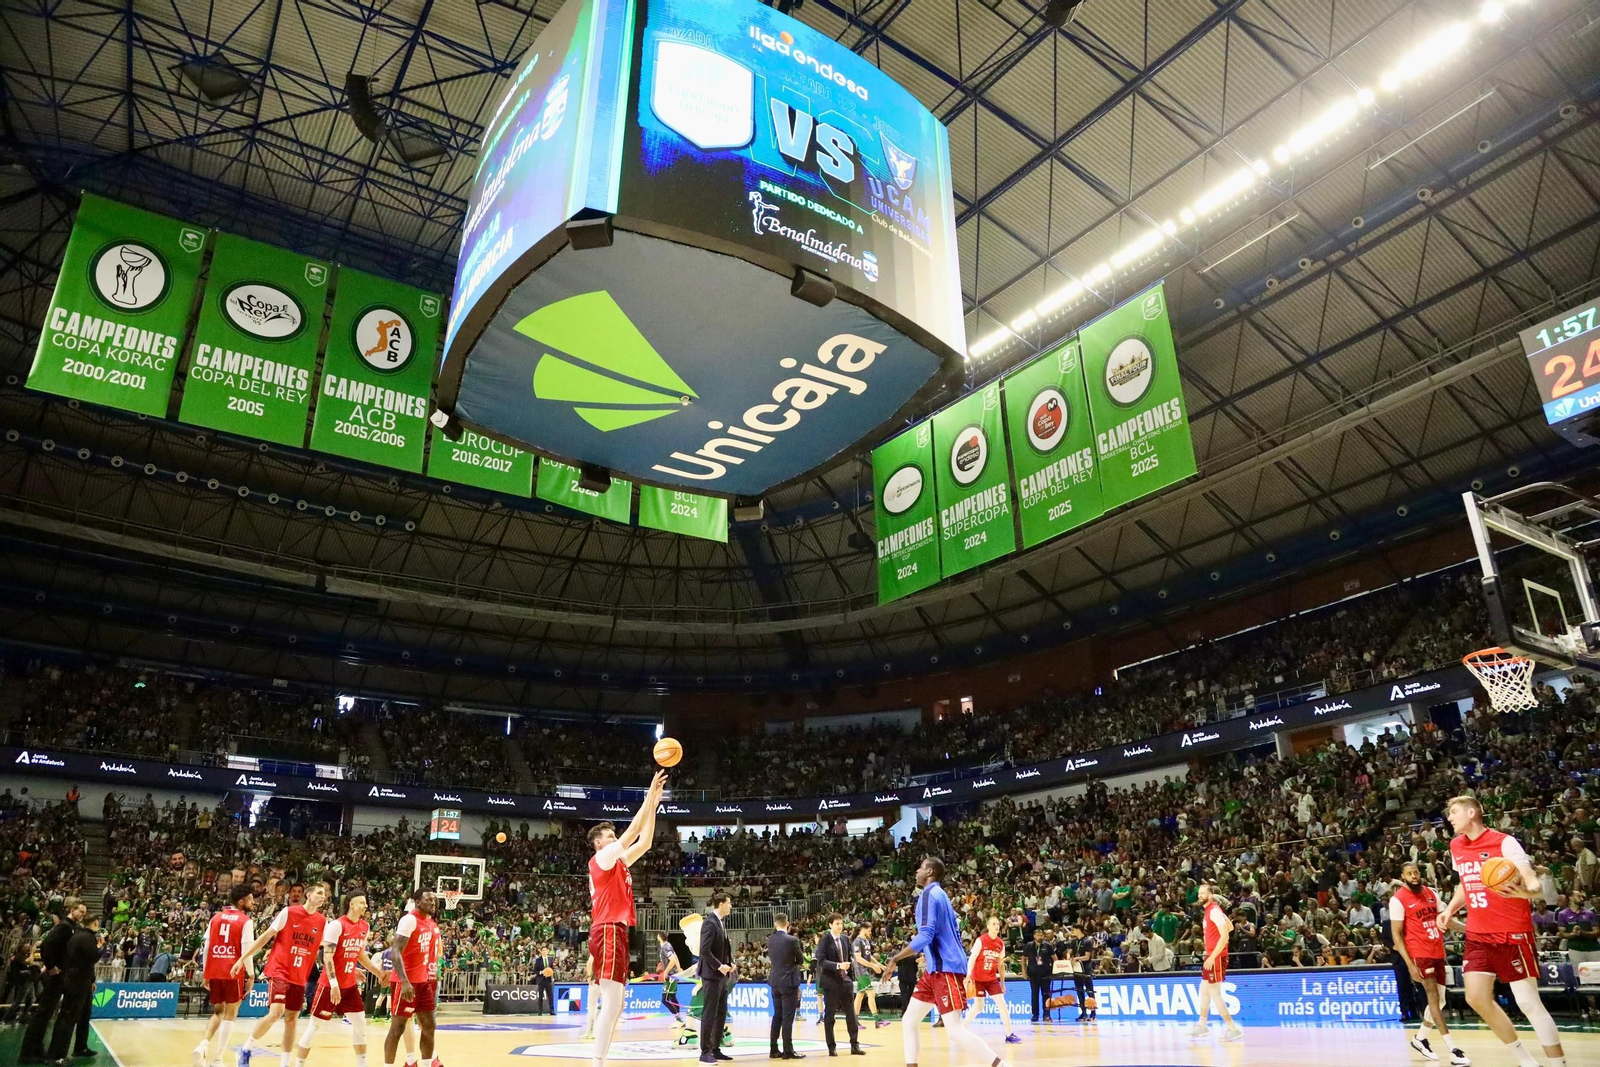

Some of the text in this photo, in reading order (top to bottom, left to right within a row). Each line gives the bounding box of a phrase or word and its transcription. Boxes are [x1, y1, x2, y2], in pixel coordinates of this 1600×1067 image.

[750, 25, 790, 56] liga
[792, 50, 868, 101] endesa
[770, 97, 855, 183] VS
[759, 180, 864, 235] PARTIDO DEDICADO A
[868, 177, 931, 232] UCAM
[871, 213, 888, 228] Club
[889, 224, 898, 234] de
[762, 216, 863, 270] Benalmádena
[236, 297, 272, 319] Rey
[247, 294, 280, 312] Copa
[49, 306, 177, 360] CAMPEONES
[1536, 307, 1597, 348] 1:57
[51, 332, 166, 372] COPA KORAC
[386, 326, 402, 363] ACB
[62, 357, 146, 390] 2000/2001
[197, 343, 309, 391] CAMPEONES
[191, 365, 308, 405] COPA DEL REY
[228, 396, 264, 416] 2005
[324, 375, 426, 419] CAMPEONES
[651, 333, 888, 480] Unicaja
[1579, 391, 1600, 408] Uni
[349, 405, 397, 431] ACB
[1098, 397, 1181, 454] CAMPEONES
[334, 420, 406, 448] 2005/2006
[452, 448, 512, 473] 2016/2017
[1130, 441, 1155, 460] BCL
[1020, 447, 1094, 499] CAMPEONES
[1131, 453, 1159, 477] 2025
[674, 491, 697, 504] BCL
[1023, 468, 1094, 509] COPA DEL REY
[670, 502, 698, 518] 2024
[941, 482, 1008, 527] CAMPEONES
[1048, 500, 1072, 521] 2025
[943, 503, 1010, 541] SUPERCOPA
[878, 516, 933, 559] CAMPEONES
[964, 531, 987, 550] 2024
[901, 553, 911, 561] CUP
[897, 562, 918, 580] 2024
[1404, 682, 1421, 690] Junta
[440, 820, 457, 833] 24
[1458, 861, 1483, 876] UCA
[1463, 874, 1482, 882] MURC
[1469, 892, 1489, 908] 35
[219, 923, 231, 943] 4
[293, 932, 315, 944] UCAM
[342, 938, 364, 948] UCAM
[1427, 927, 1440, 940] 30
[293, 956, 303, 968] 13
[344, 961, 354, 974] 12
[1547, 964, 1559, 978] 3
[118, 989, 174, 999] Fundación
[1302, 978, 1323, 995] La
[117, 999, 158, 1011] Unicaja
[630, 998, 661, 1009] choice
[727, 987, 769, 1008] AHAVIS
[1089, 982, 1241, 1015] ENAHAVS
[1279, 997, 1315, 1015] más
